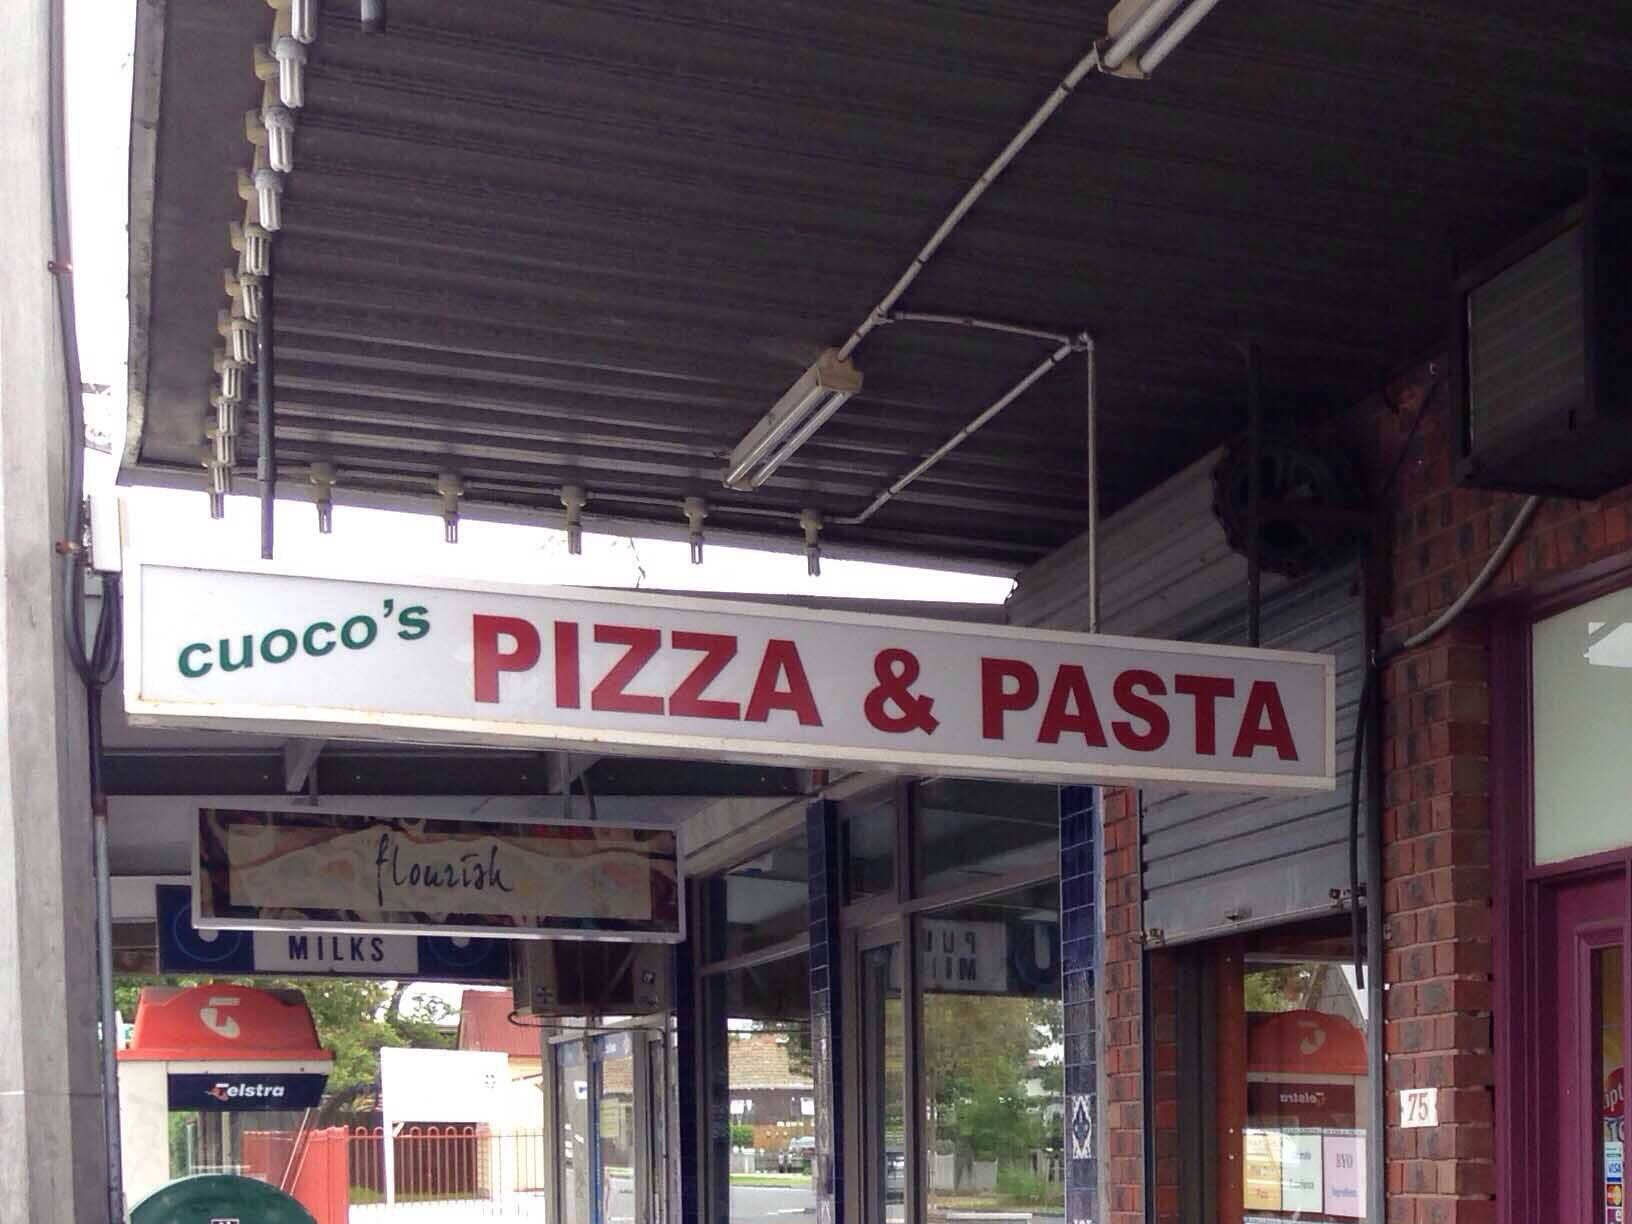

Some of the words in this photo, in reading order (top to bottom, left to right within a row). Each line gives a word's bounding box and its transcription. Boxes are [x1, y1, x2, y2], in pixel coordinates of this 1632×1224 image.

[178, 598, 430, 678] cuoco's
[472, 613, 823, 727] PIZZA
[864, 647, 940, 735] &
[981, 656, 1299, 761] PASTA
[377, 833, 512, 906] flourish
[289, 936, 384, 962] MILKS
[207, 1083, 285, 1101] Telstra
[1408, 1092, 1429, 1121] 75
